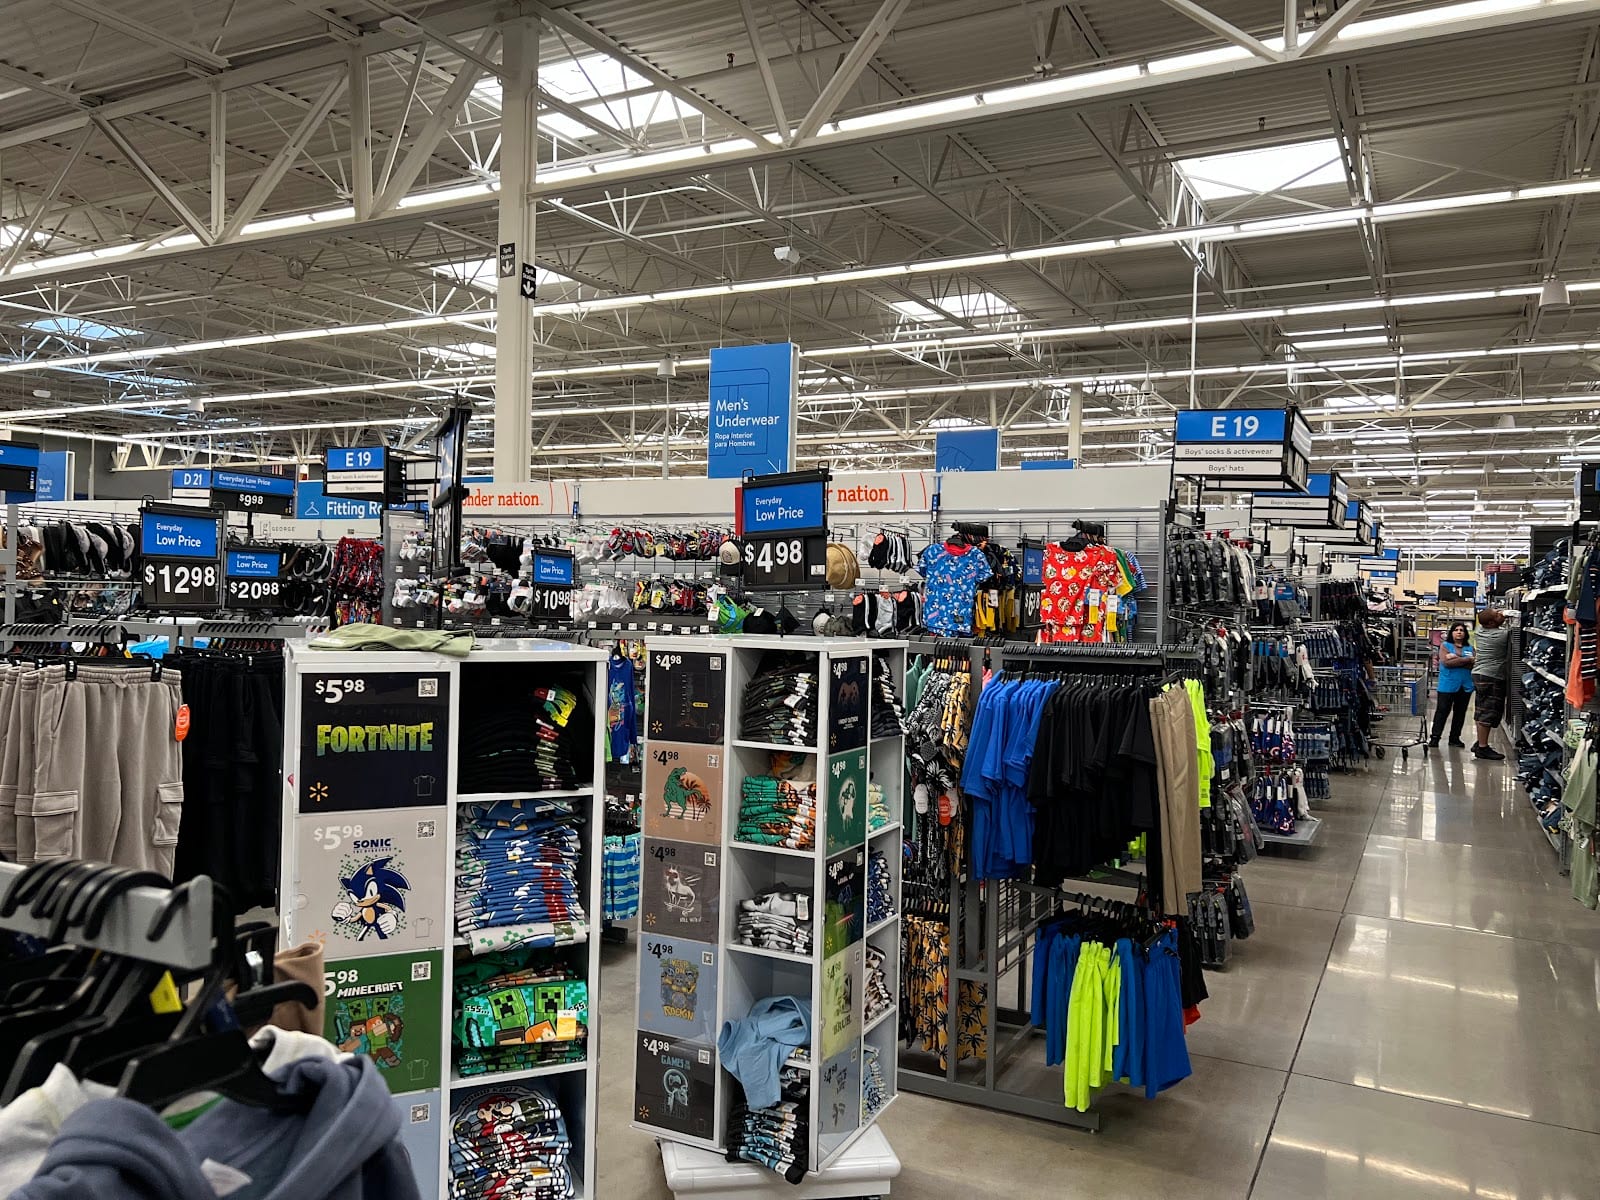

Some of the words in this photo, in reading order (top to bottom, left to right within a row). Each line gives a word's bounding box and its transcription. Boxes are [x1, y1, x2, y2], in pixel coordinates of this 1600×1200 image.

[715, 398, 749, 412] Men's
[715, 414, 780, 428] Underwear
[1211, 416, 1227, 437] E
[1233, 415, 1260, 437] 19
[714, 432, 730, 441] Ropa
[730, 431, 753, 439] Interior
[345, 452, 354, 467] E
[357, 451, 372, 467] 19
[1208, 464, 1228, 472] Boys'
[1229, 464, 1245, 472] hats
[183, 473, 192, 486] D
[192, 473, 203, 486] 21
[219, 474, 245, 484] Everyday
[257, 478, 271, 486] Price
[462, 488, 494, 506] nder
[497, 491, 539, 506] nation
[755, 496, 782, 506] Everyday
[837, 485, 889, 502] nation
[326, 501, 365, 519] Fitting
[755, 509, 775, 522] Low
[777, 506, 804, 520] Price
[156, 522, 183, 533] Everyday
[156, 533, 176, 546] Low
[178, 535, 202, 548] Price
[236, 560, 250, 569] Low
[251, 561, 268, 569] Price
[540, 565, 551, 574] Low
[551, 566, 564, 575] Price
[655, 654, 682, 671] $498
[315, 679, 365, 704] $598
[316, 721, 434, 757] FORTNITE
[653, 750, 679, 766] $498
[313, 824, 363, 850] $598
[353, 838, 392, 849] SONIC
[647, 942, 673, 959] $498
[323, 969, 358, 997] 598
[336, 981, 404, 998] MINECRAFT
[643, 1037, 670, 1056] $498
